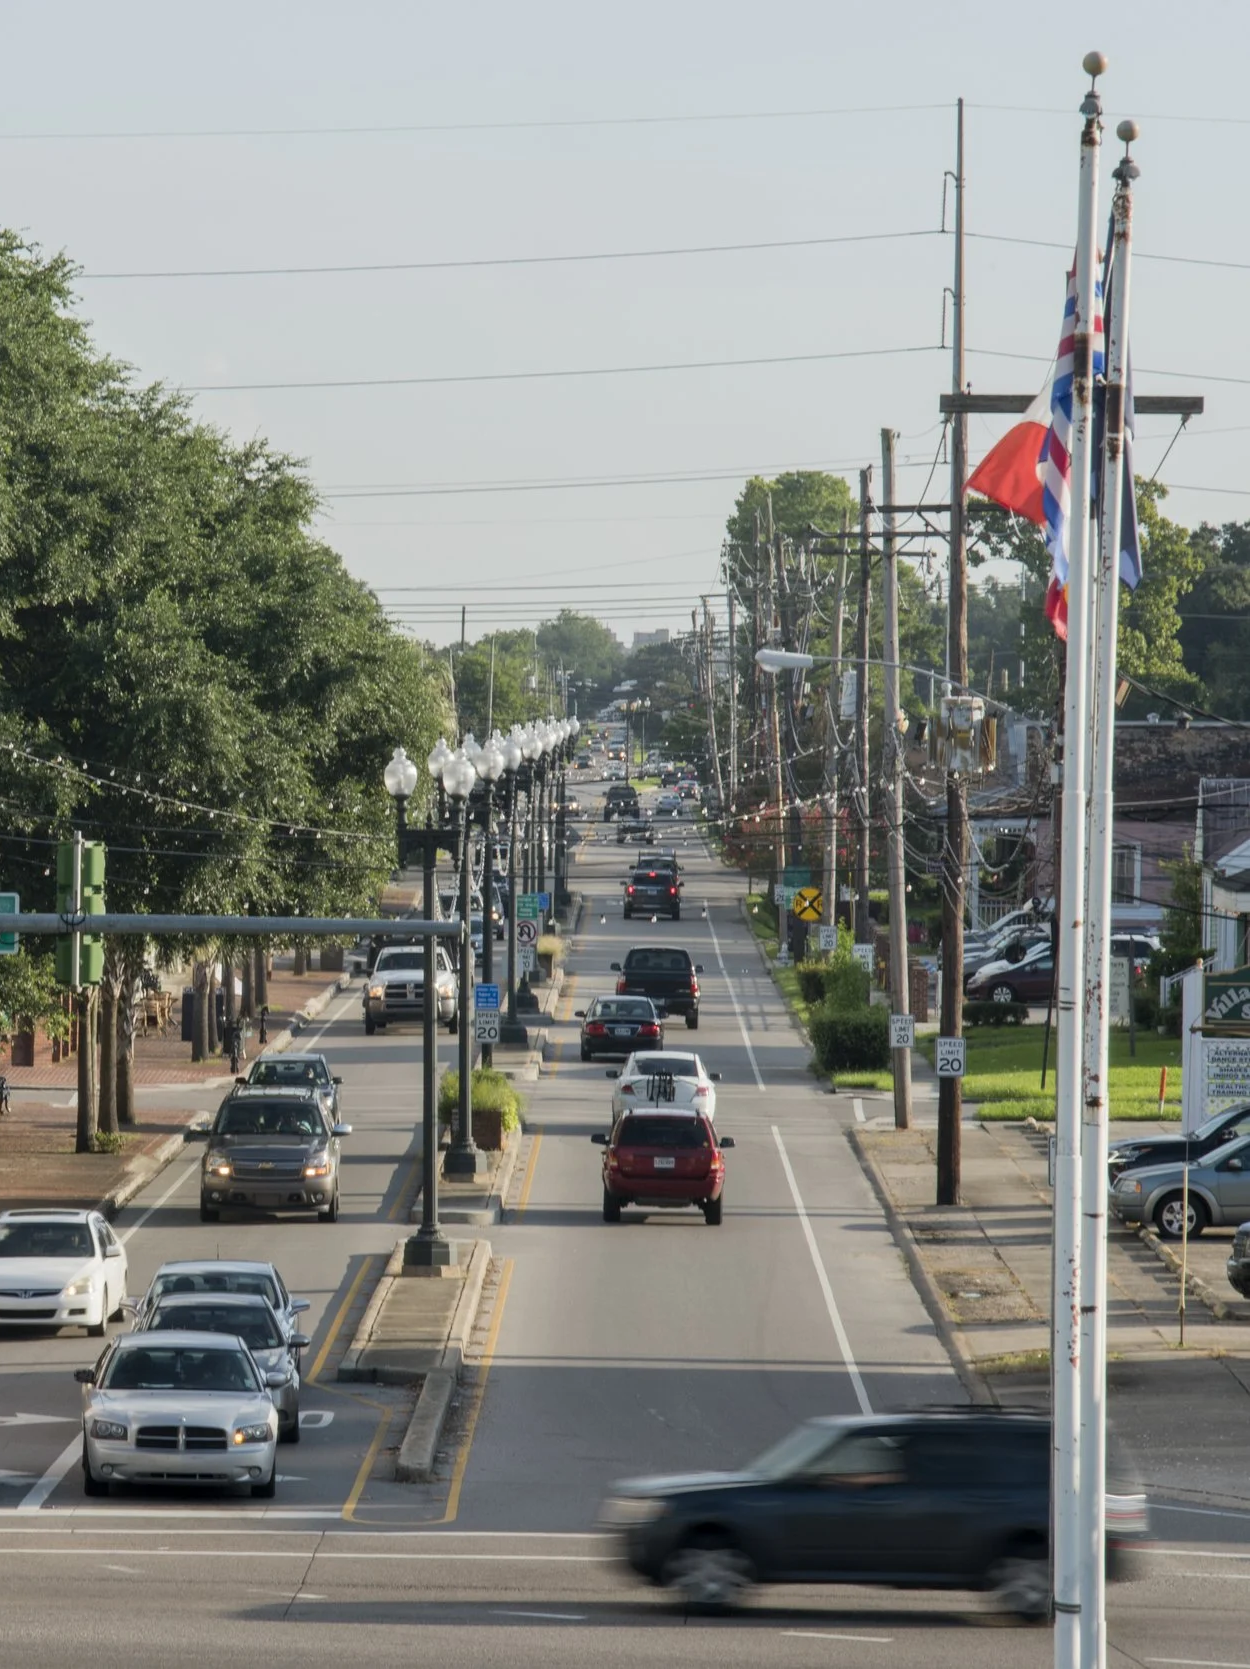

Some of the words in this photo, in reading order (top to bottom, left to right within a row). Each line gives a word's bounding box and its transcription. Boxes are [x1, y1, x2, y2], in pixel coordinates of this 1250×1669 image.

[796, 901, 803, 909] R
[477, 1026, 498, 1039] 20
[896, 1034, 909, 1044] 20
[939, 1058, 962, 1072] 20
